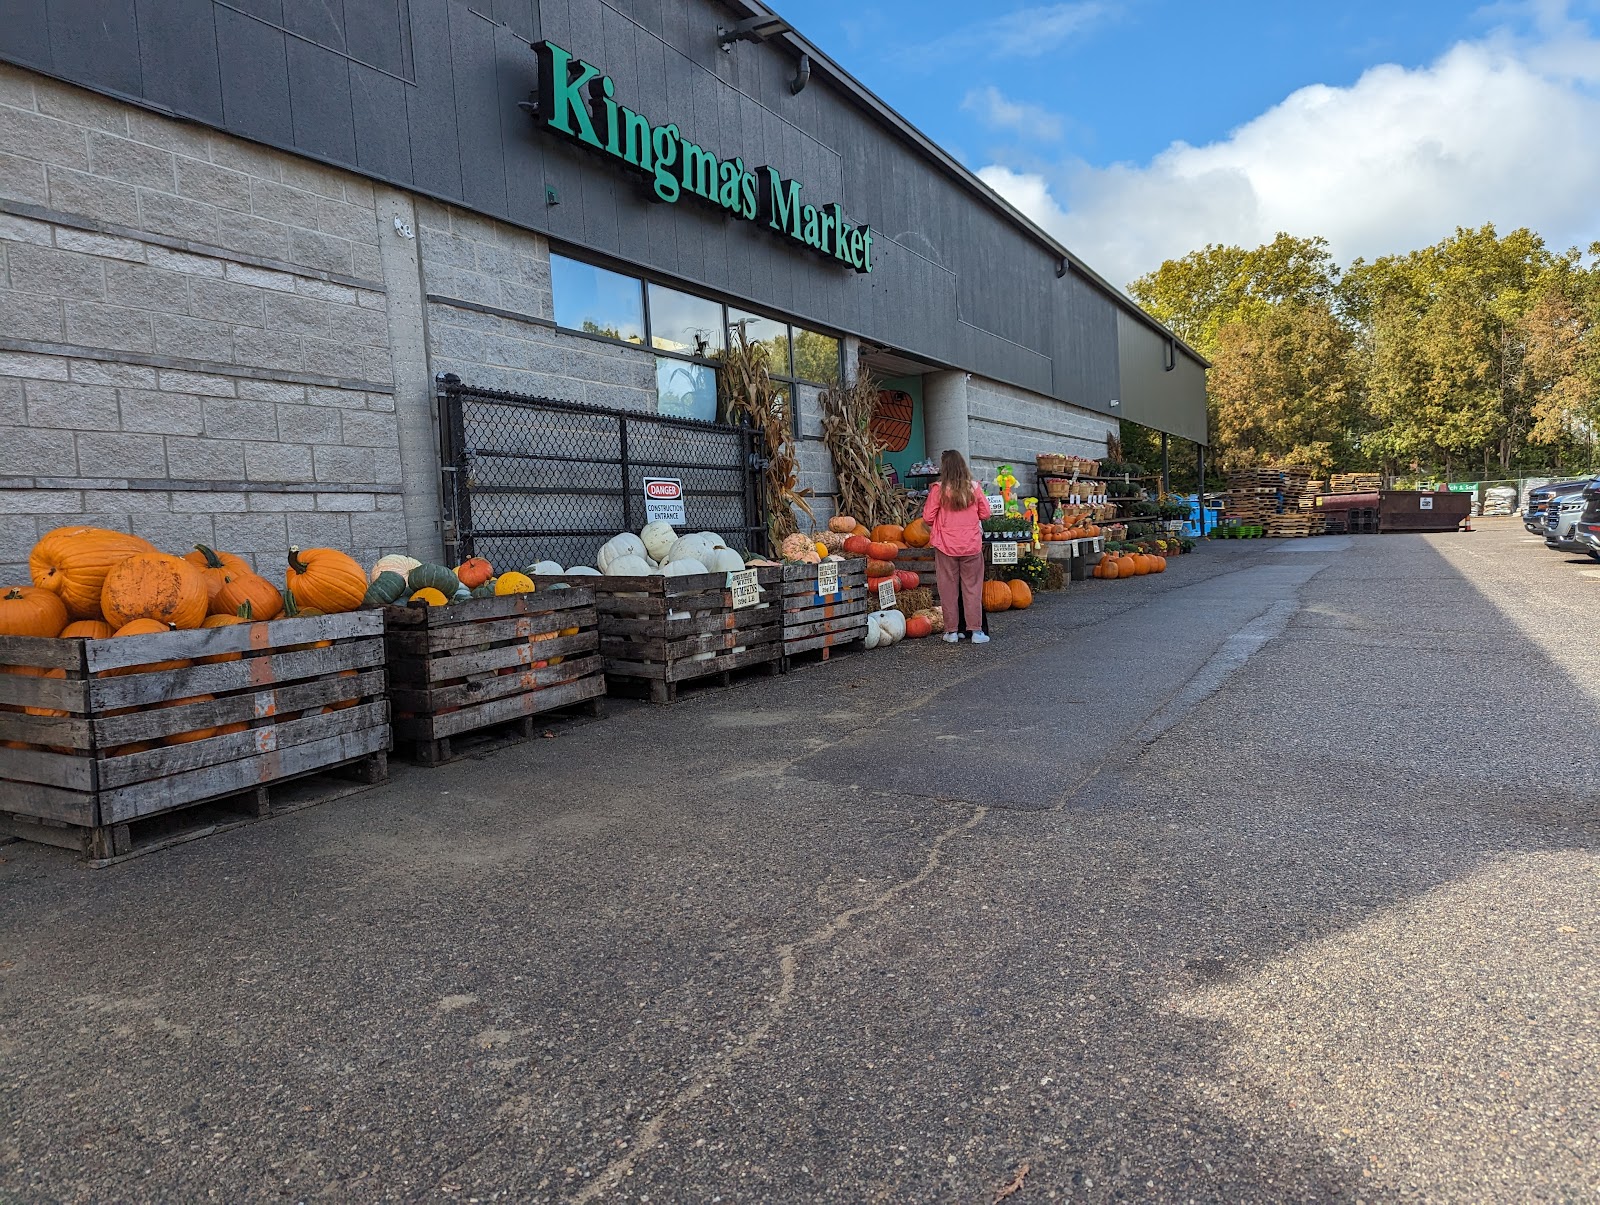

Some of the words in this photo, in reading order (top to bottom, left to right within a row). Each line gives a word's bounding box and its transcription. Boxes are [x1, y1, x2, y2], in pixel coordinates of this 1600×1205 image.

[544, 40, 757, 220] Kingma's
[765, 165, 874, 274] Market
[650, 486, 676, 494] DANGER
[733, 583, 758, 599] PUMPKINS
